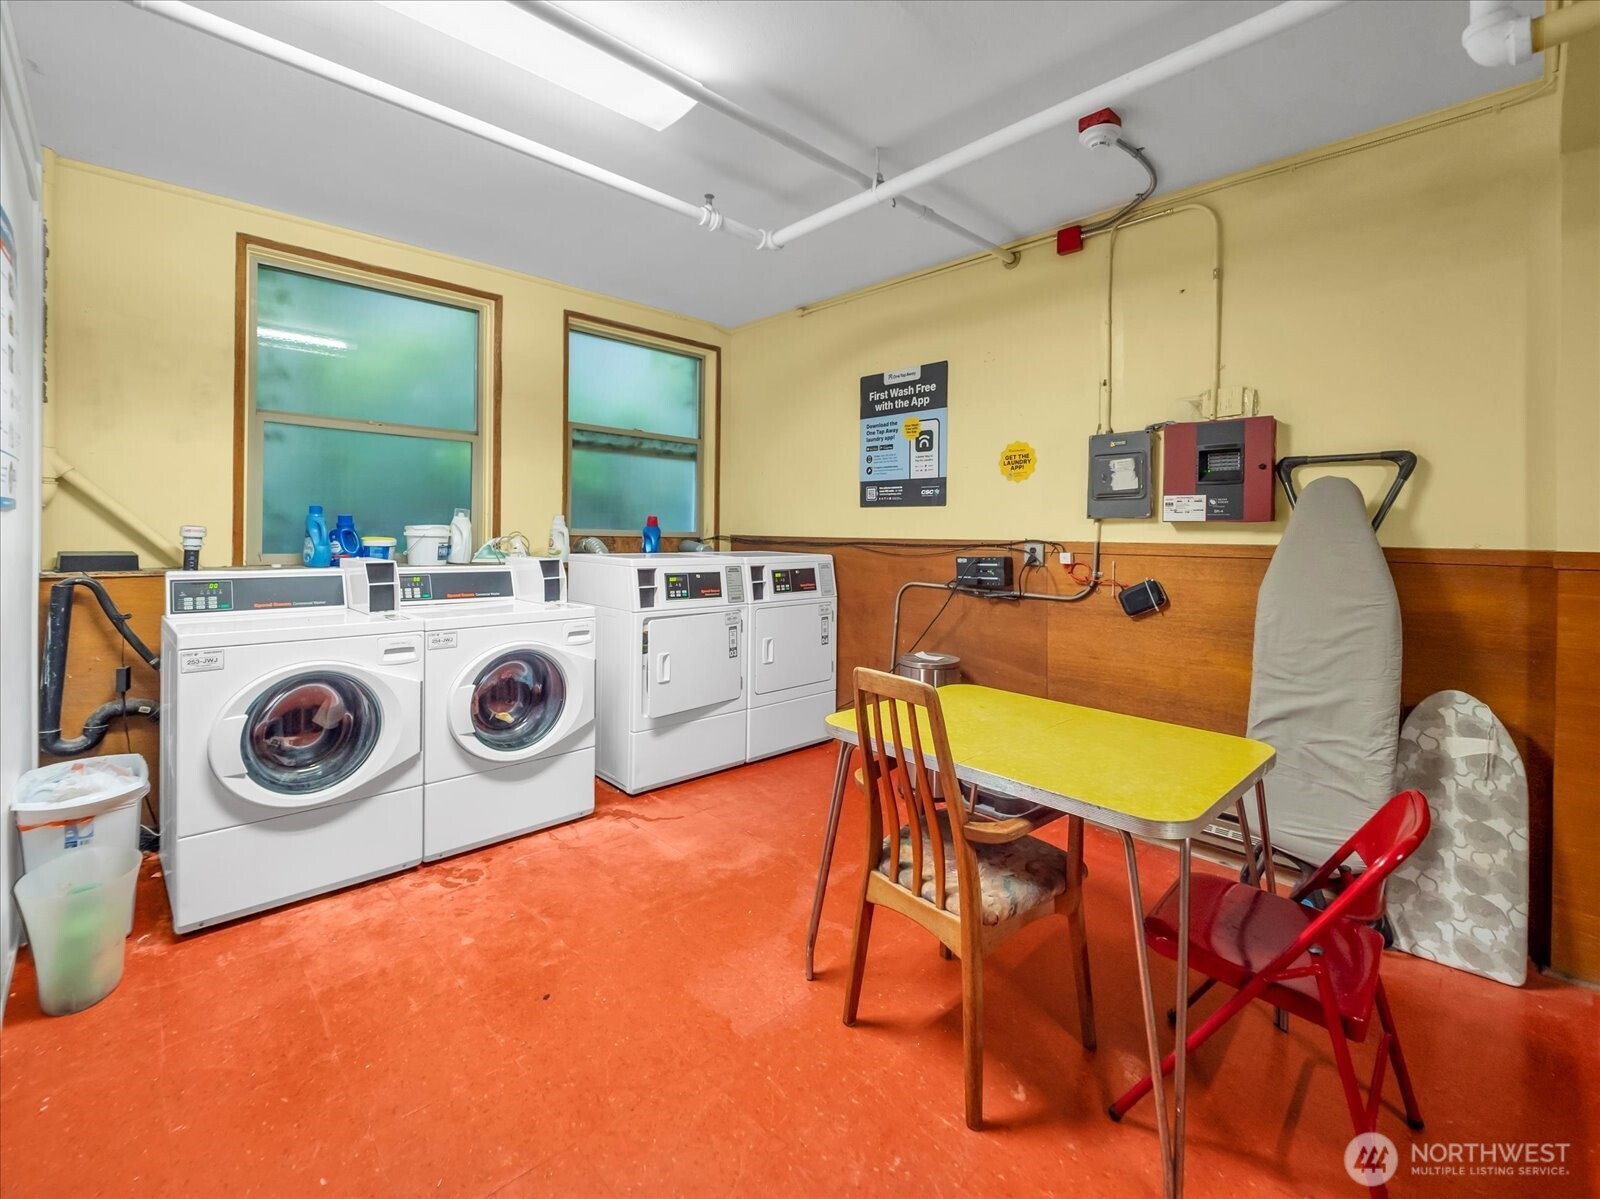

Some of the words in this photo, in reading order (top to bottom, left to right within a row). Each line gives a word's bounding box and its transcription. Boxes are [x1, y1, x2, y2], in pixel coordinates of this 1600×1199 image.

[870, 390, 888, 401] First
[890, 386, 914, 398] Wash
[916, 383, 936, 393] Free
[875, 402, 894, 412] with
[895, 400, 909, 408] the
[911, 396, 930, 408] App
